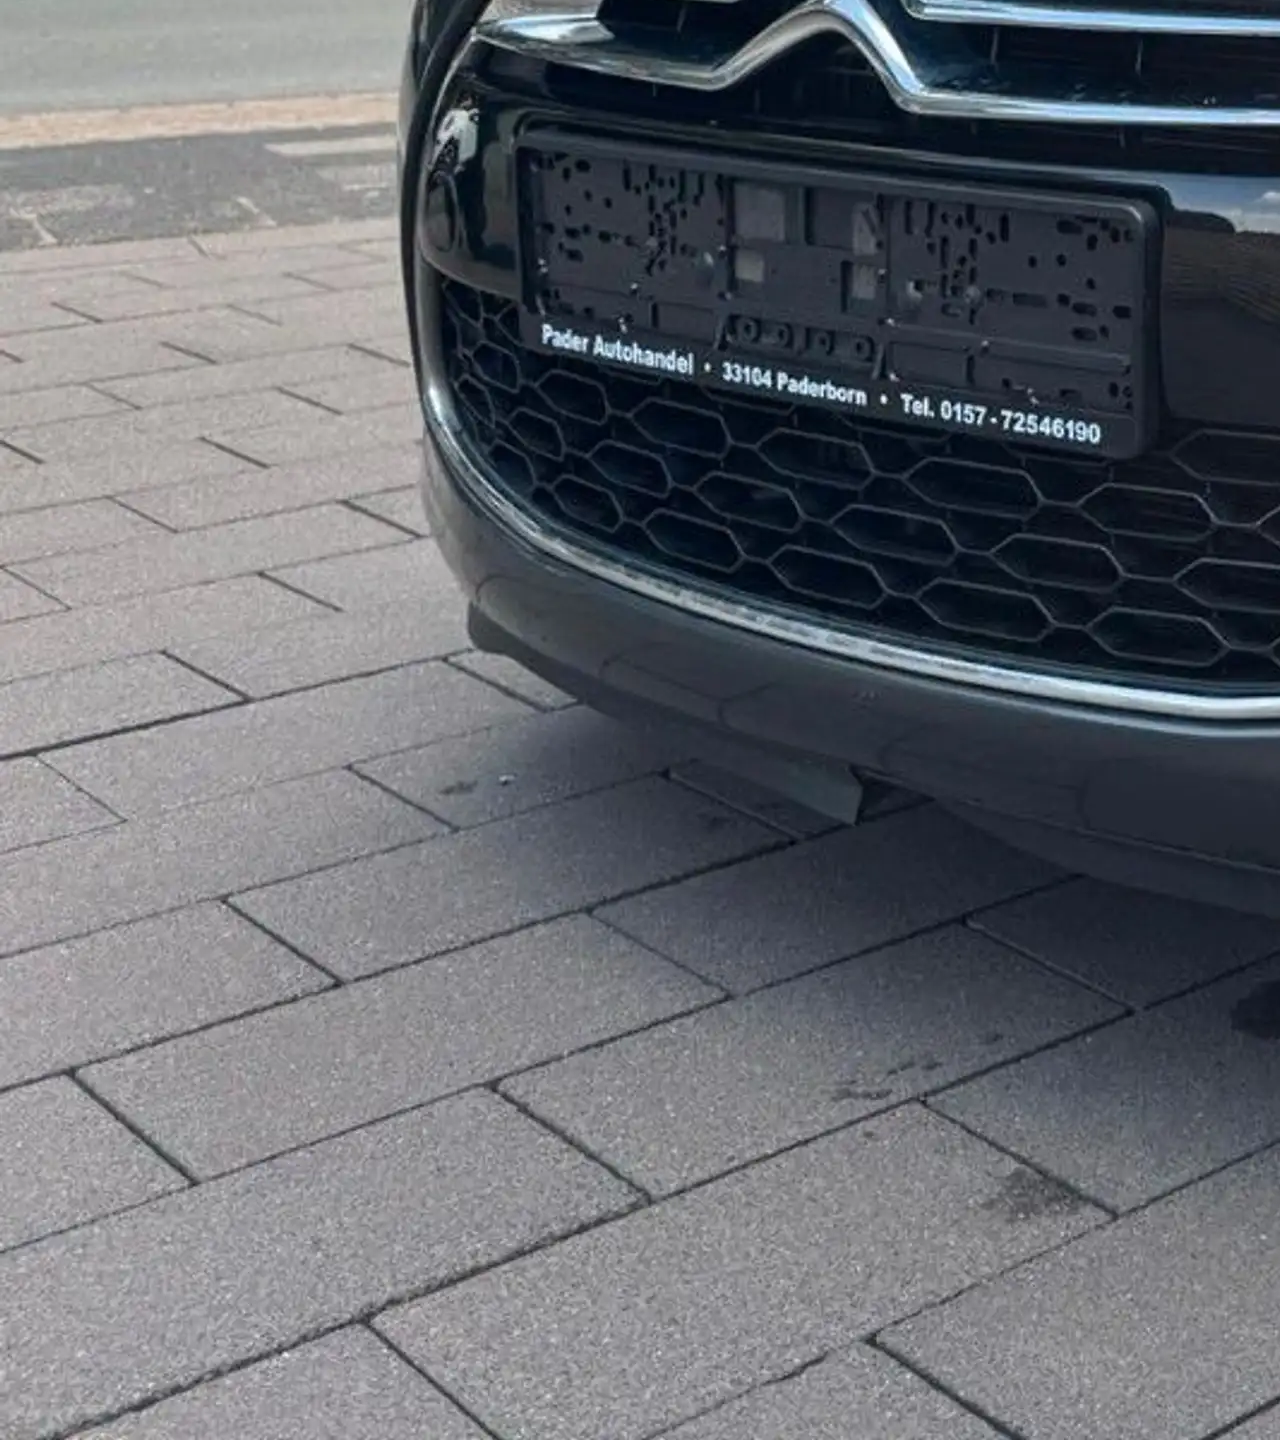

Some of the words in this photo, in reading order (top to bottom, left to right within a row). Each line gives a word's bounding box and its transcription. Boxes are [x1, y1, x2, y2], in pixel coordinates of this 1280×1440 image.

[541, 323, 588, 353] Pader
[593, 334, 694, 375] Autohandel
[722, 361, 772, 388] 33104
[777, 371, 868, 406] Paderborn
[900, 393, 935, 418] Tel.
